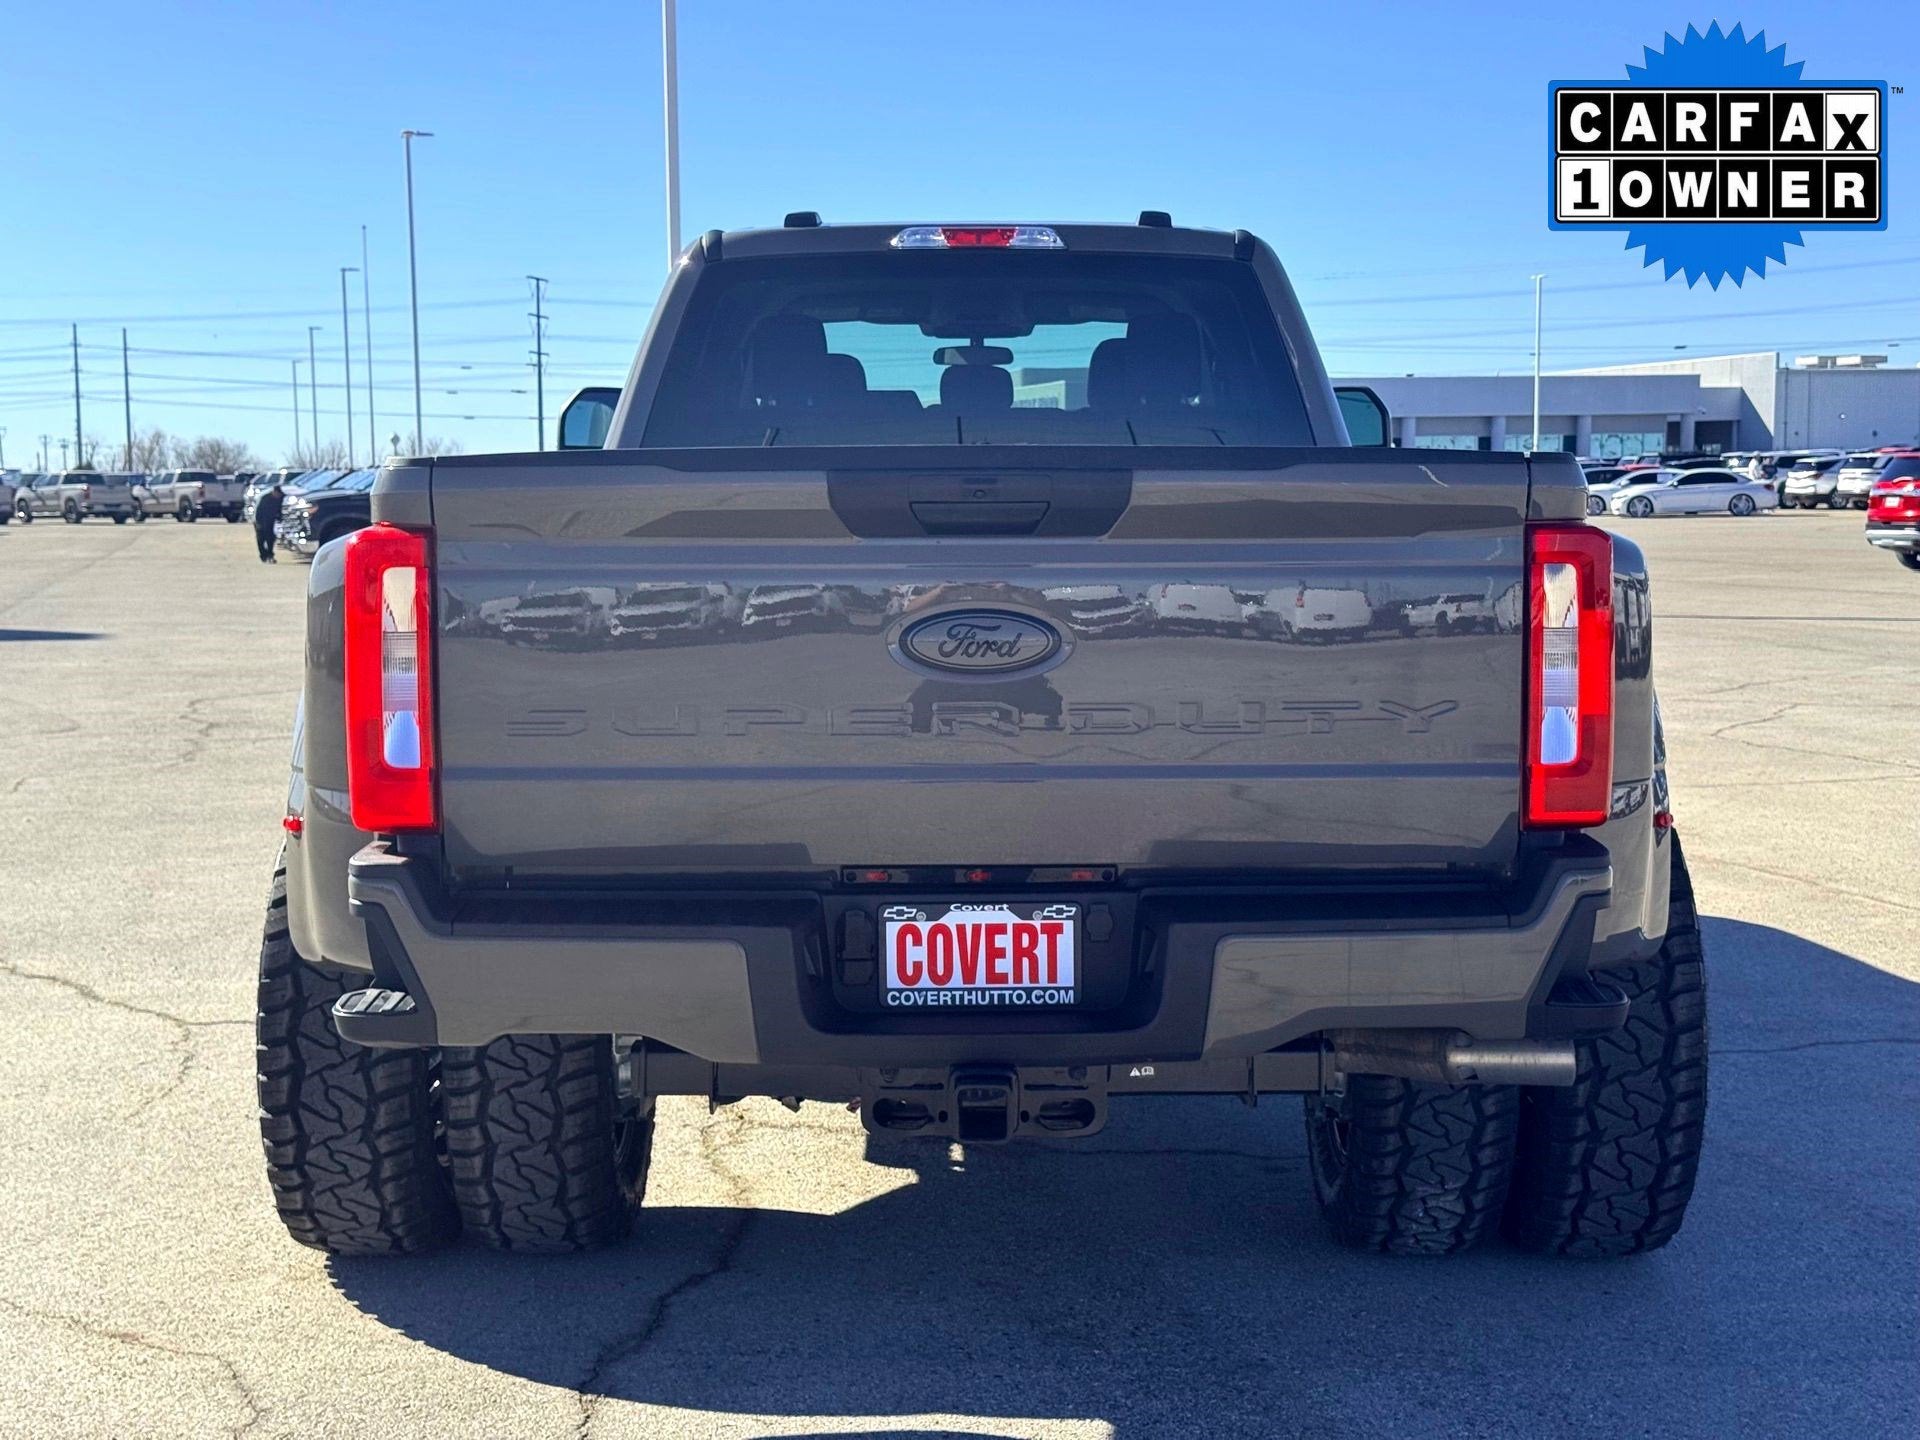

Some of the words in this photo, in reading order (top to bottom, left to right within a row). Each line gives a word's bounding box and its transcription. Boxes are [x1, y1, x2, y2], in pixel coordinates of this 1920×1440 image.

[937, 623, 1023, 658] Ford
[505, 700, 1020, 737] SUPER
[1066, 700, 1461, 735] DUTY
[950, 903, 1010, 912] Covert
[896, 923, 1064, 986] COVERT
[887, 990, 1075, 1006] COVERTHUTTO.COM
